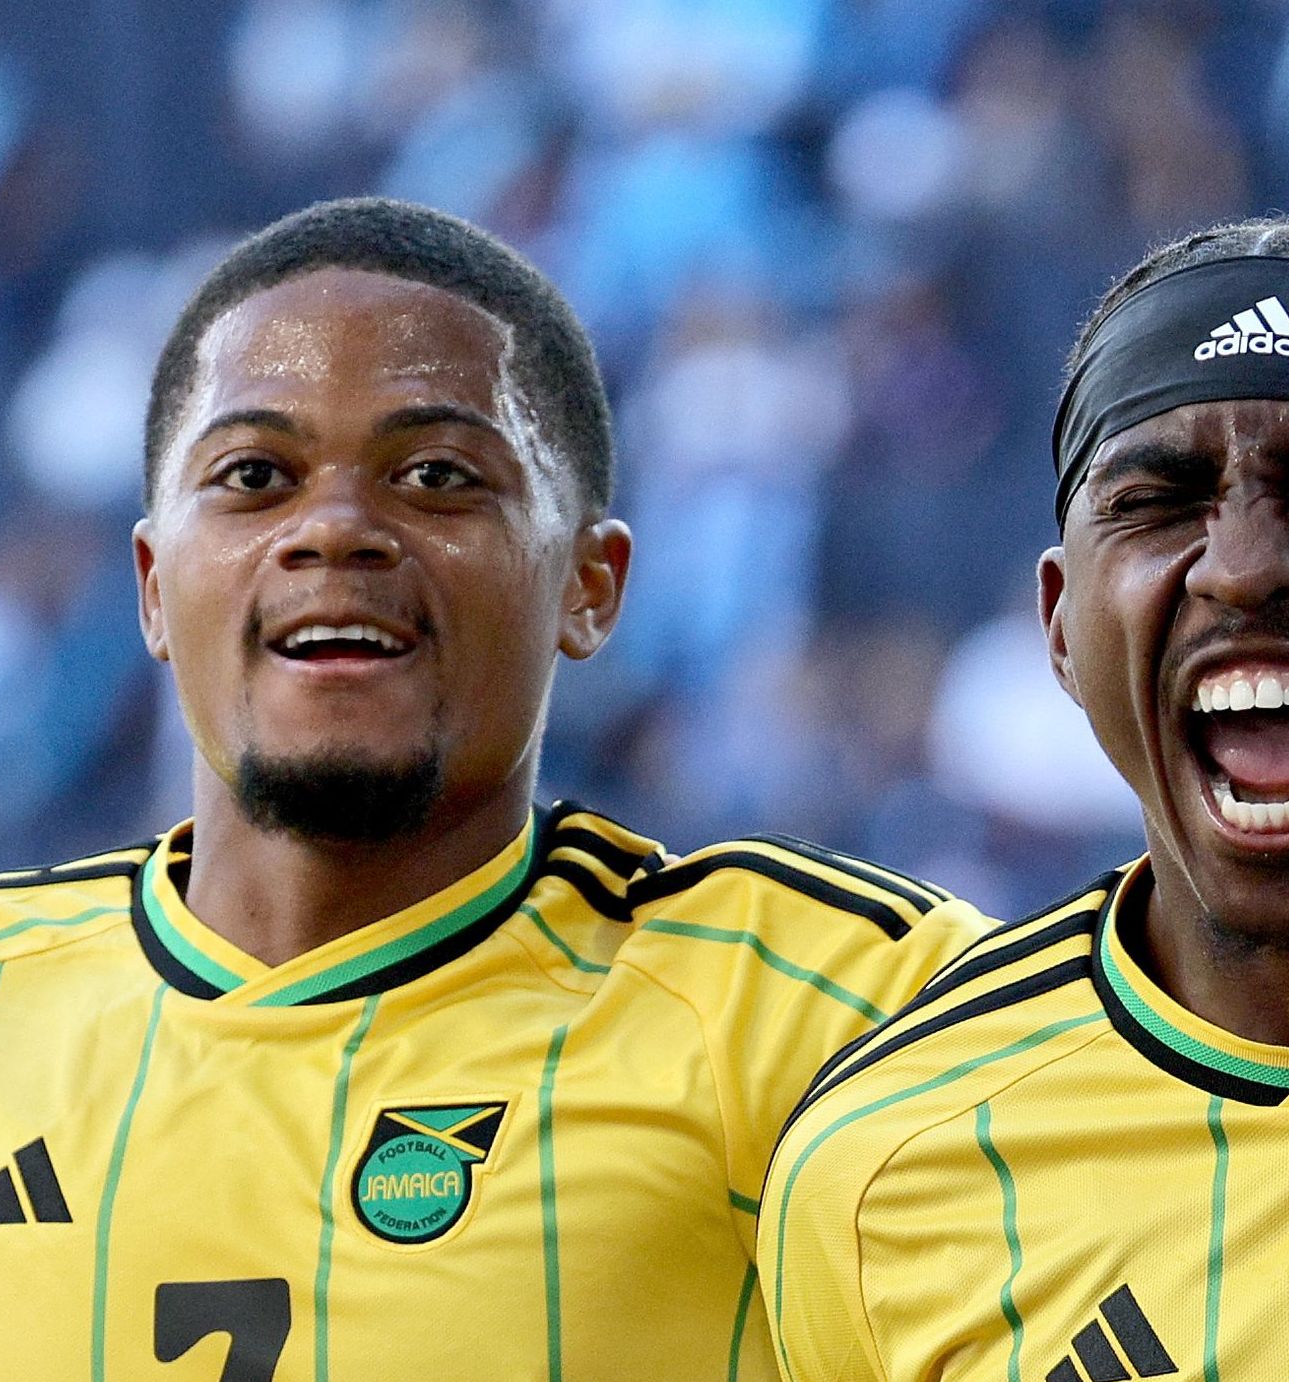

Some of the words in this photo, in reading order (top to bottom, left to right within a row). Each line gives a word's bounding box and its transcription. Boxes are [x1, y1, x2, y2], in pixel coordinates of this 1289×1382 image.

[377, 1140, 447, 1164] FOOTBALL
[362, 1171, 461, 1201] JAMAICA
[373, 1207, 447, 1231] FEDERATION
